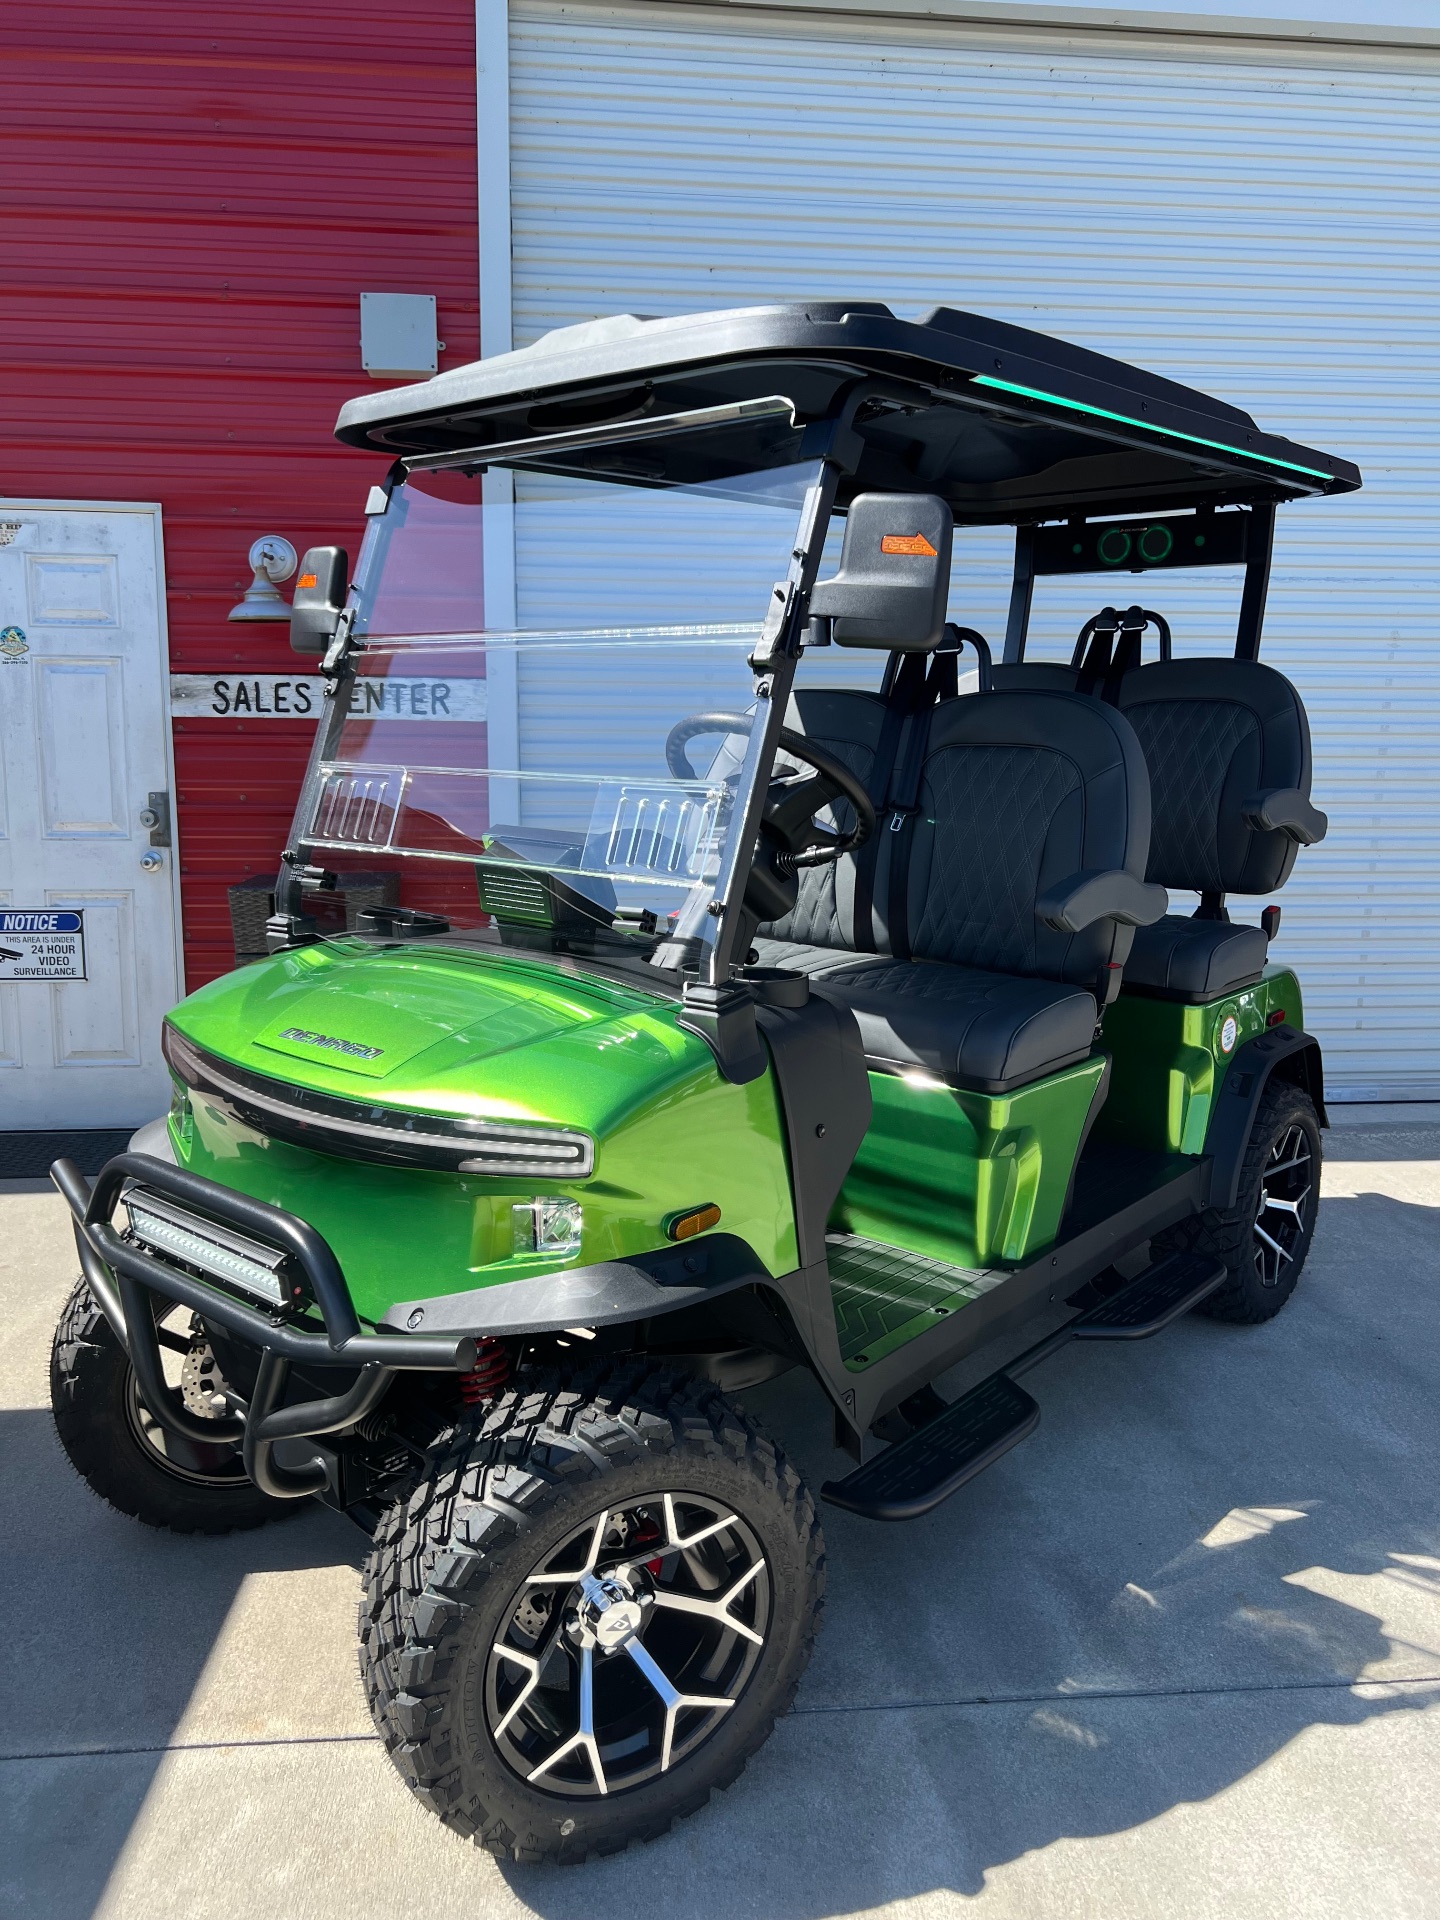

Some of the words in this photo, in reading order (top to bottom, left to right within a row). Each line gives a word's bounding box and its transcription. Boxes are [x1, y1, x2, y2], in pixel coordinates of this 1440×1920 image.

[212, 680, 312, 714] SALES
[346, 682, 451, 716] ENTER
[3, 914, 58, 930] NOTICE
[31, 944, 44, 954] 24
[47, 944, 75, 954] HOUR
[38, 956, 70, 966] VIDEO
[13, 967, 77, 976] SURVEILLANCE
[277, 1027, 385, 1060] DENAGO
